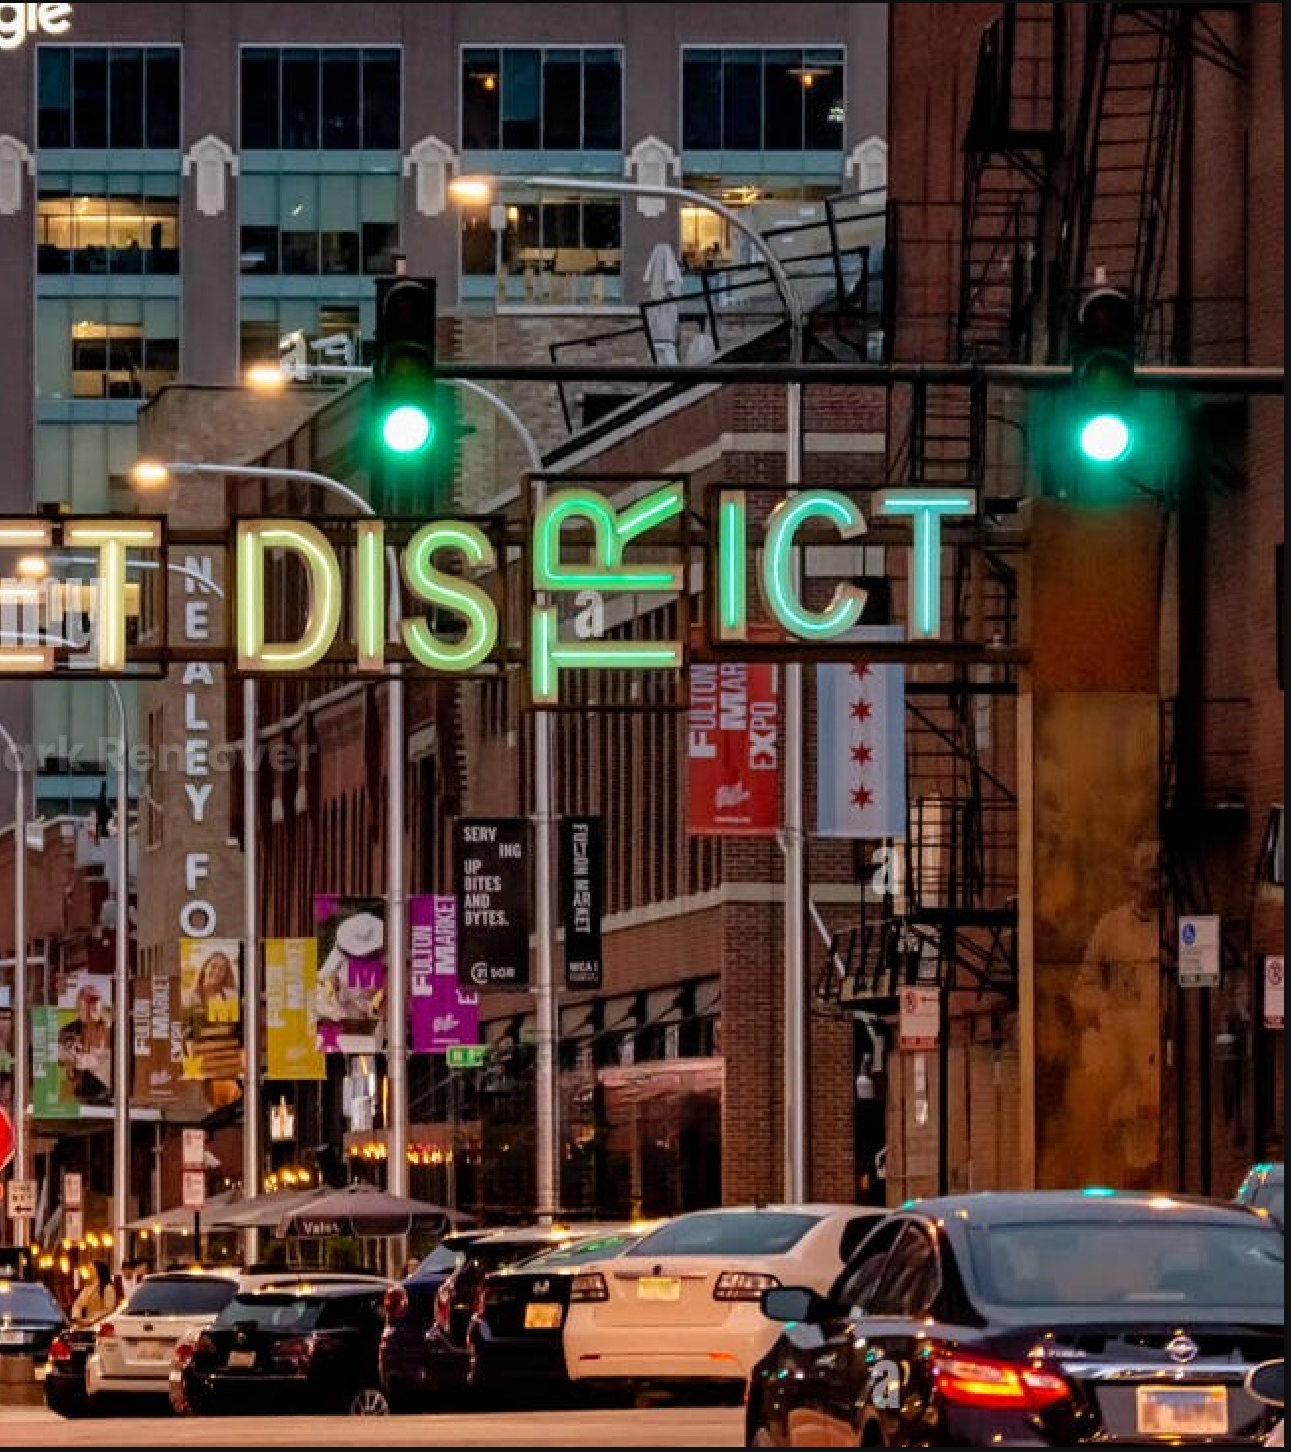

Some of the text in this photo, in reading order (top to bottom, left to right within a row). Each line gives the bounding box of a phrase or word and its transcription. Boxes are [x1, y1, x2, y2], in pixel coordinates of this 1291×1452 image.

[688, 664, 717, 758] FULTON
[750, 701, 777, 770] EXPO
[464, 826, 498, 842] SERV
[498, 843, 522, 858] ING
[464, 859, 482, 875] UP
[464, 893, 490, 909] AND
[412, 926, 434, 996] FULTON
